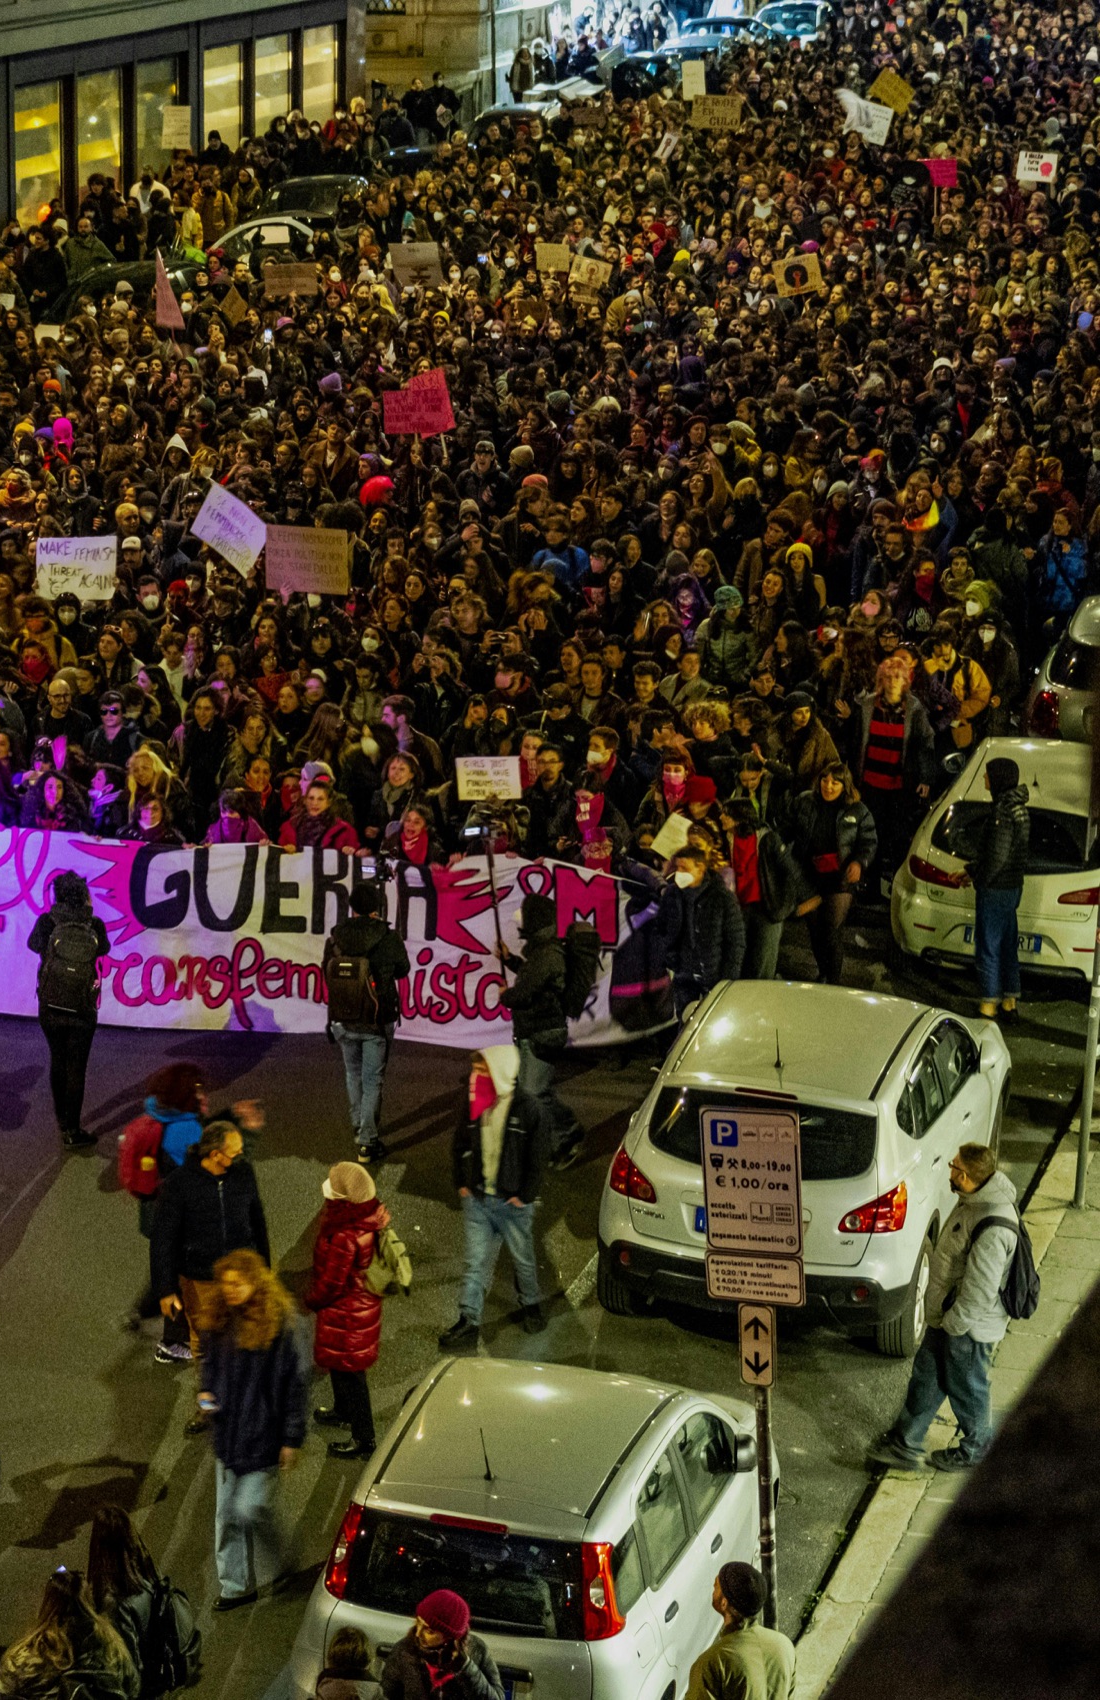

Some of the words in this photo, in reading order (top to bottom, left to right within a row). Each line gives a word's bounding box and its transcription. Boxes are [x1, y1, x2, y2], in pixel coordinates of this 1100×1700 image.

[39, 541, 72, 556] MAKE
[38, 563, 46, 574] A
[48, 562, 82, 577] THREAT
[717, 1122, 732, 1143] P
[716, 1175, 726, 1187] €
[731, 1177, 789, 1191] 1,00/ora
[711, 1211, 748, 1220] autorizzati
[711, 1232, 747, 1240] pagamento
[748, 1234, 784, 1243] telematico
[710, 1258, 753, 1267] Agevolazioni
